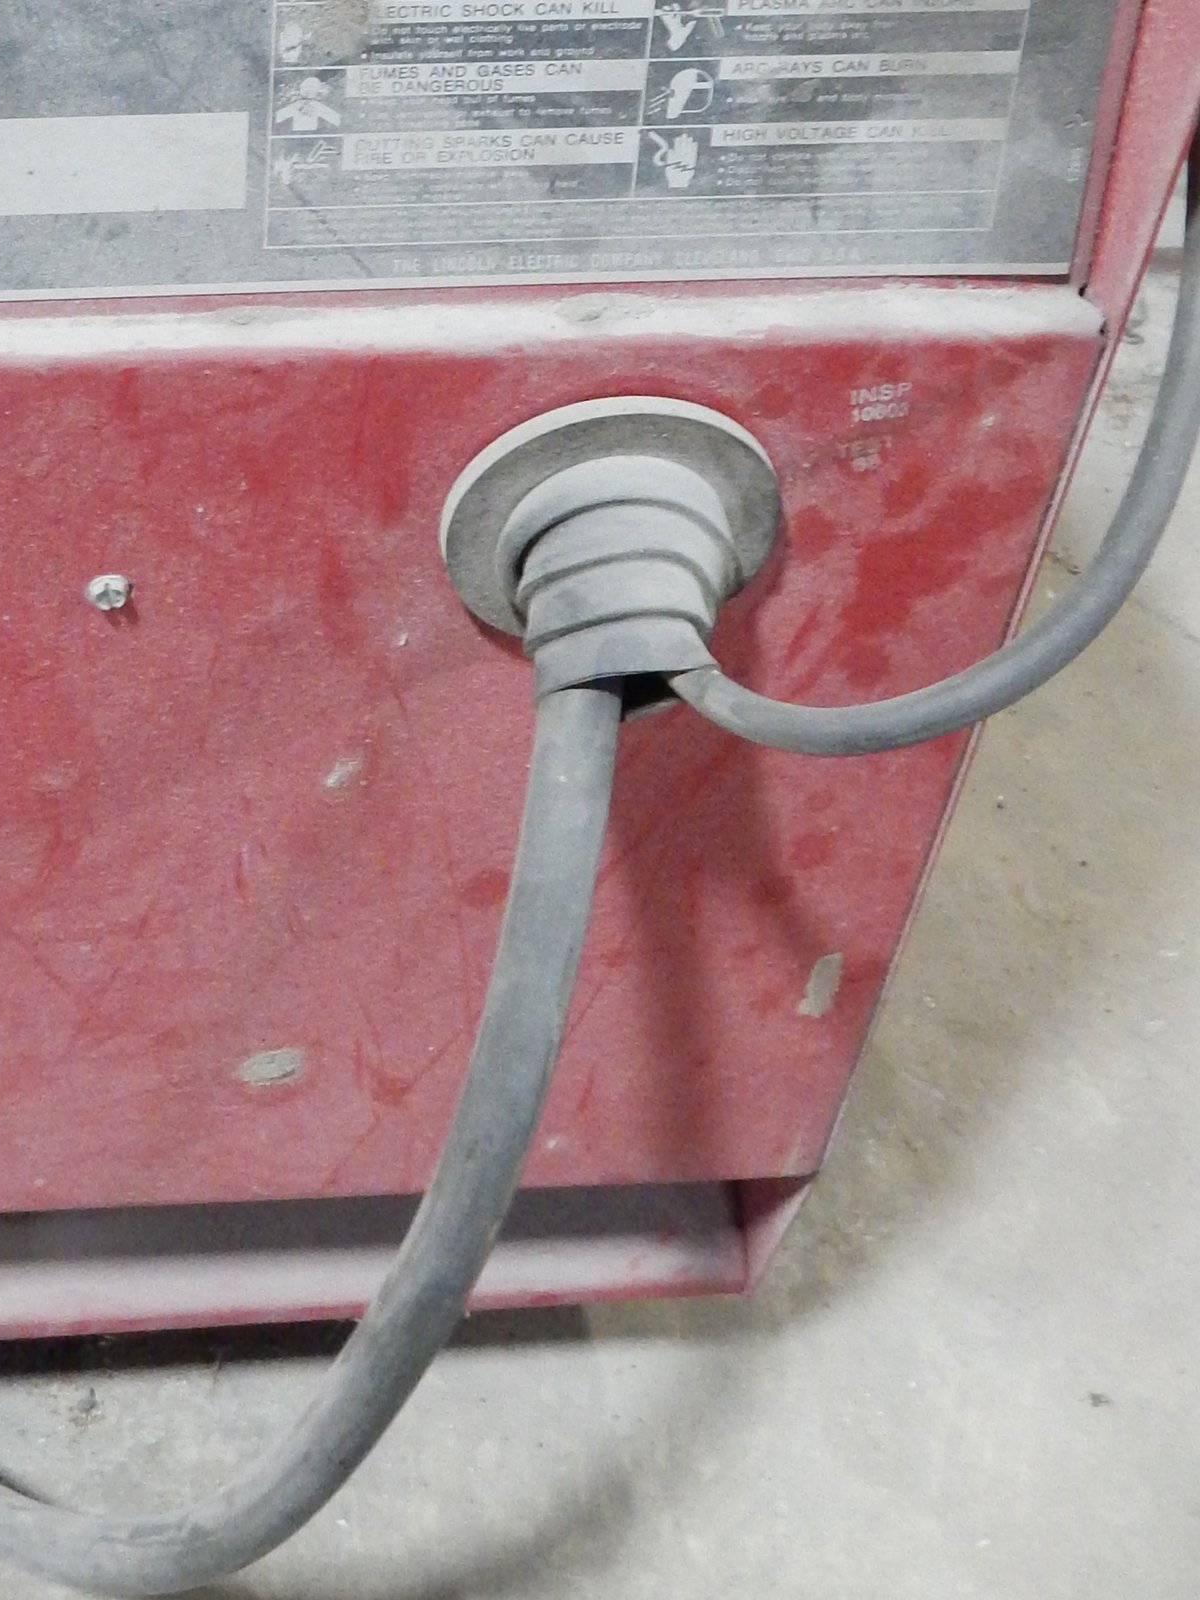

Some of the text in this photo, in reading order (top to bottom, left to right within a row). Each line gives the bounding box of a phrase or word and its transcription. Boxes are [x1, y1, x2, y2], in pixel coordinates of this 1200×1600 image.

[386, 1, 620, 19] ECTRIC SHOCK CAN KILL
[359, 62, 583, 80] FUMES AND GASES CAN
[833, 59, 871, 73] CAN
[392, 78, 504, 94] DANGEROUS
[443, 135, 513, 149] SPARKS
[521, 133, 556, 147] CAN
[566, 131, 625, 146] CAUSE
[722, 128, 767, 142] HIGH
[776, 126, 857, 141] VOLTAGE
[437, 148, 536, 163] EXPLOSION
